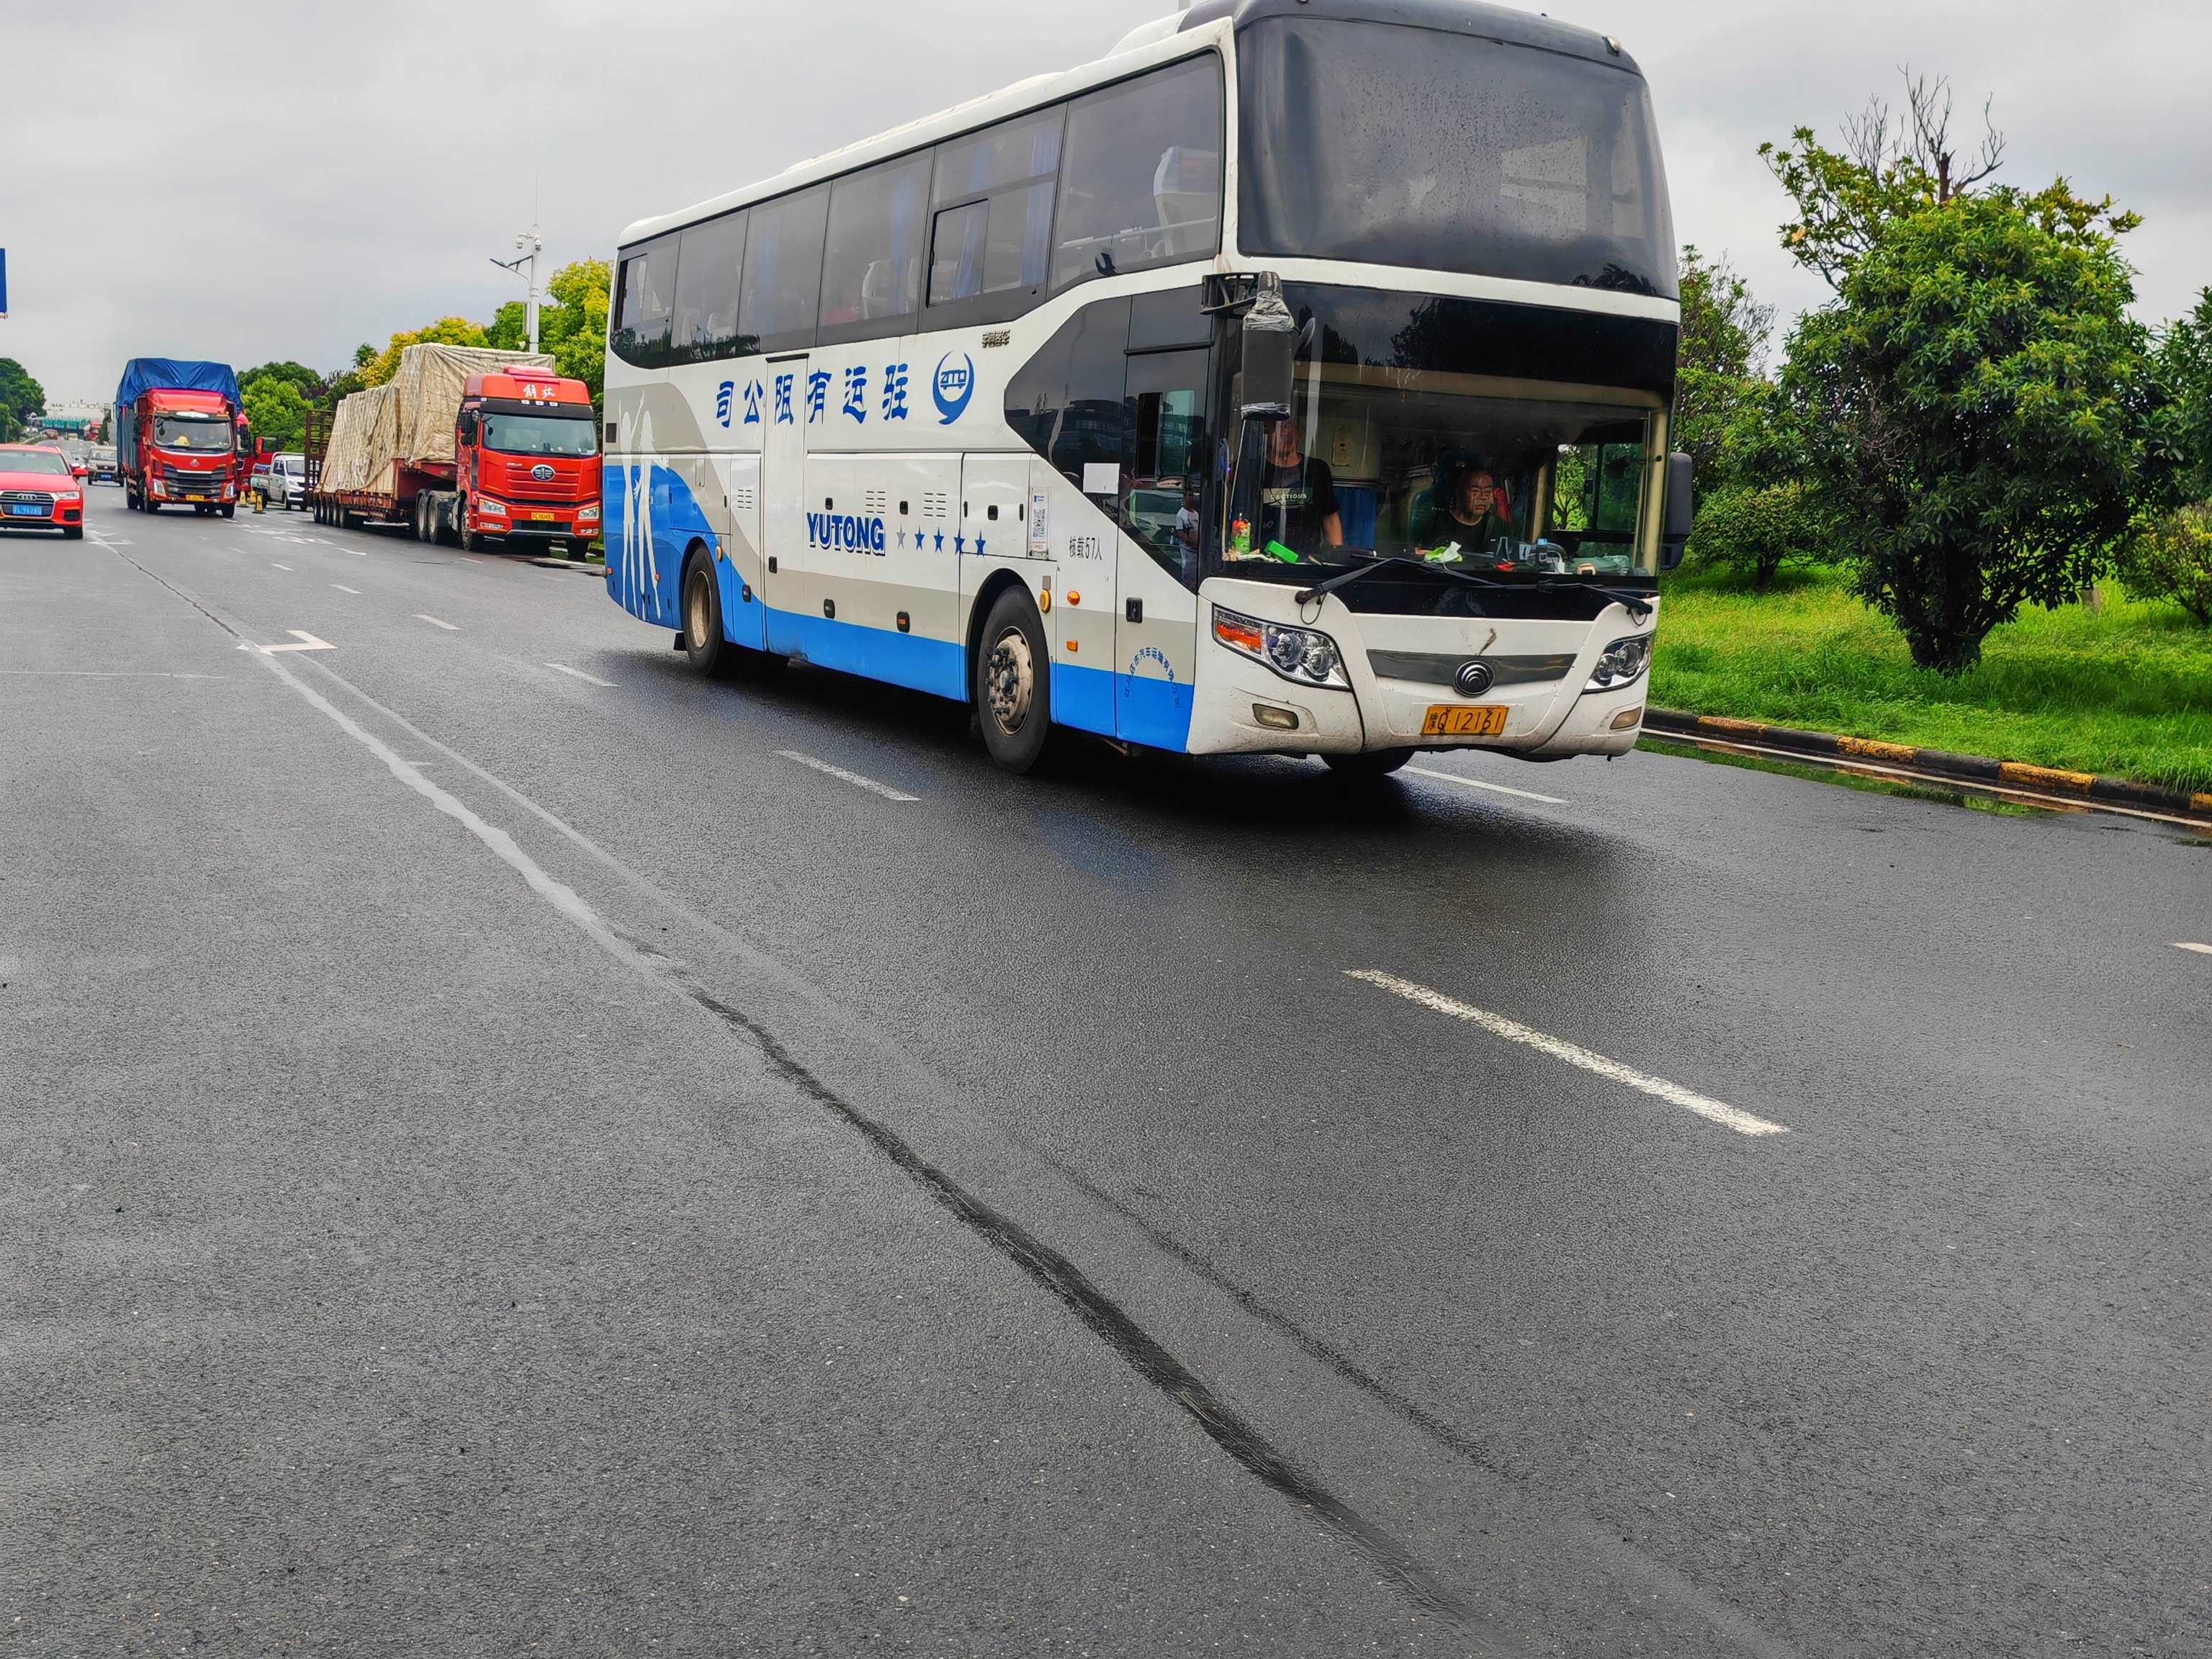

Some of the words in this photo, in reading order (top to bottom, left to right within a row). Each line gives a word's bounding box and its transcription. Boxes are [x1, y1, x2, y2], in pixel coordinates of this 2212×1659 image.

[806, 512, 886, 557] YUTONG
[1069, 536, 1102, 560] 核载57人
